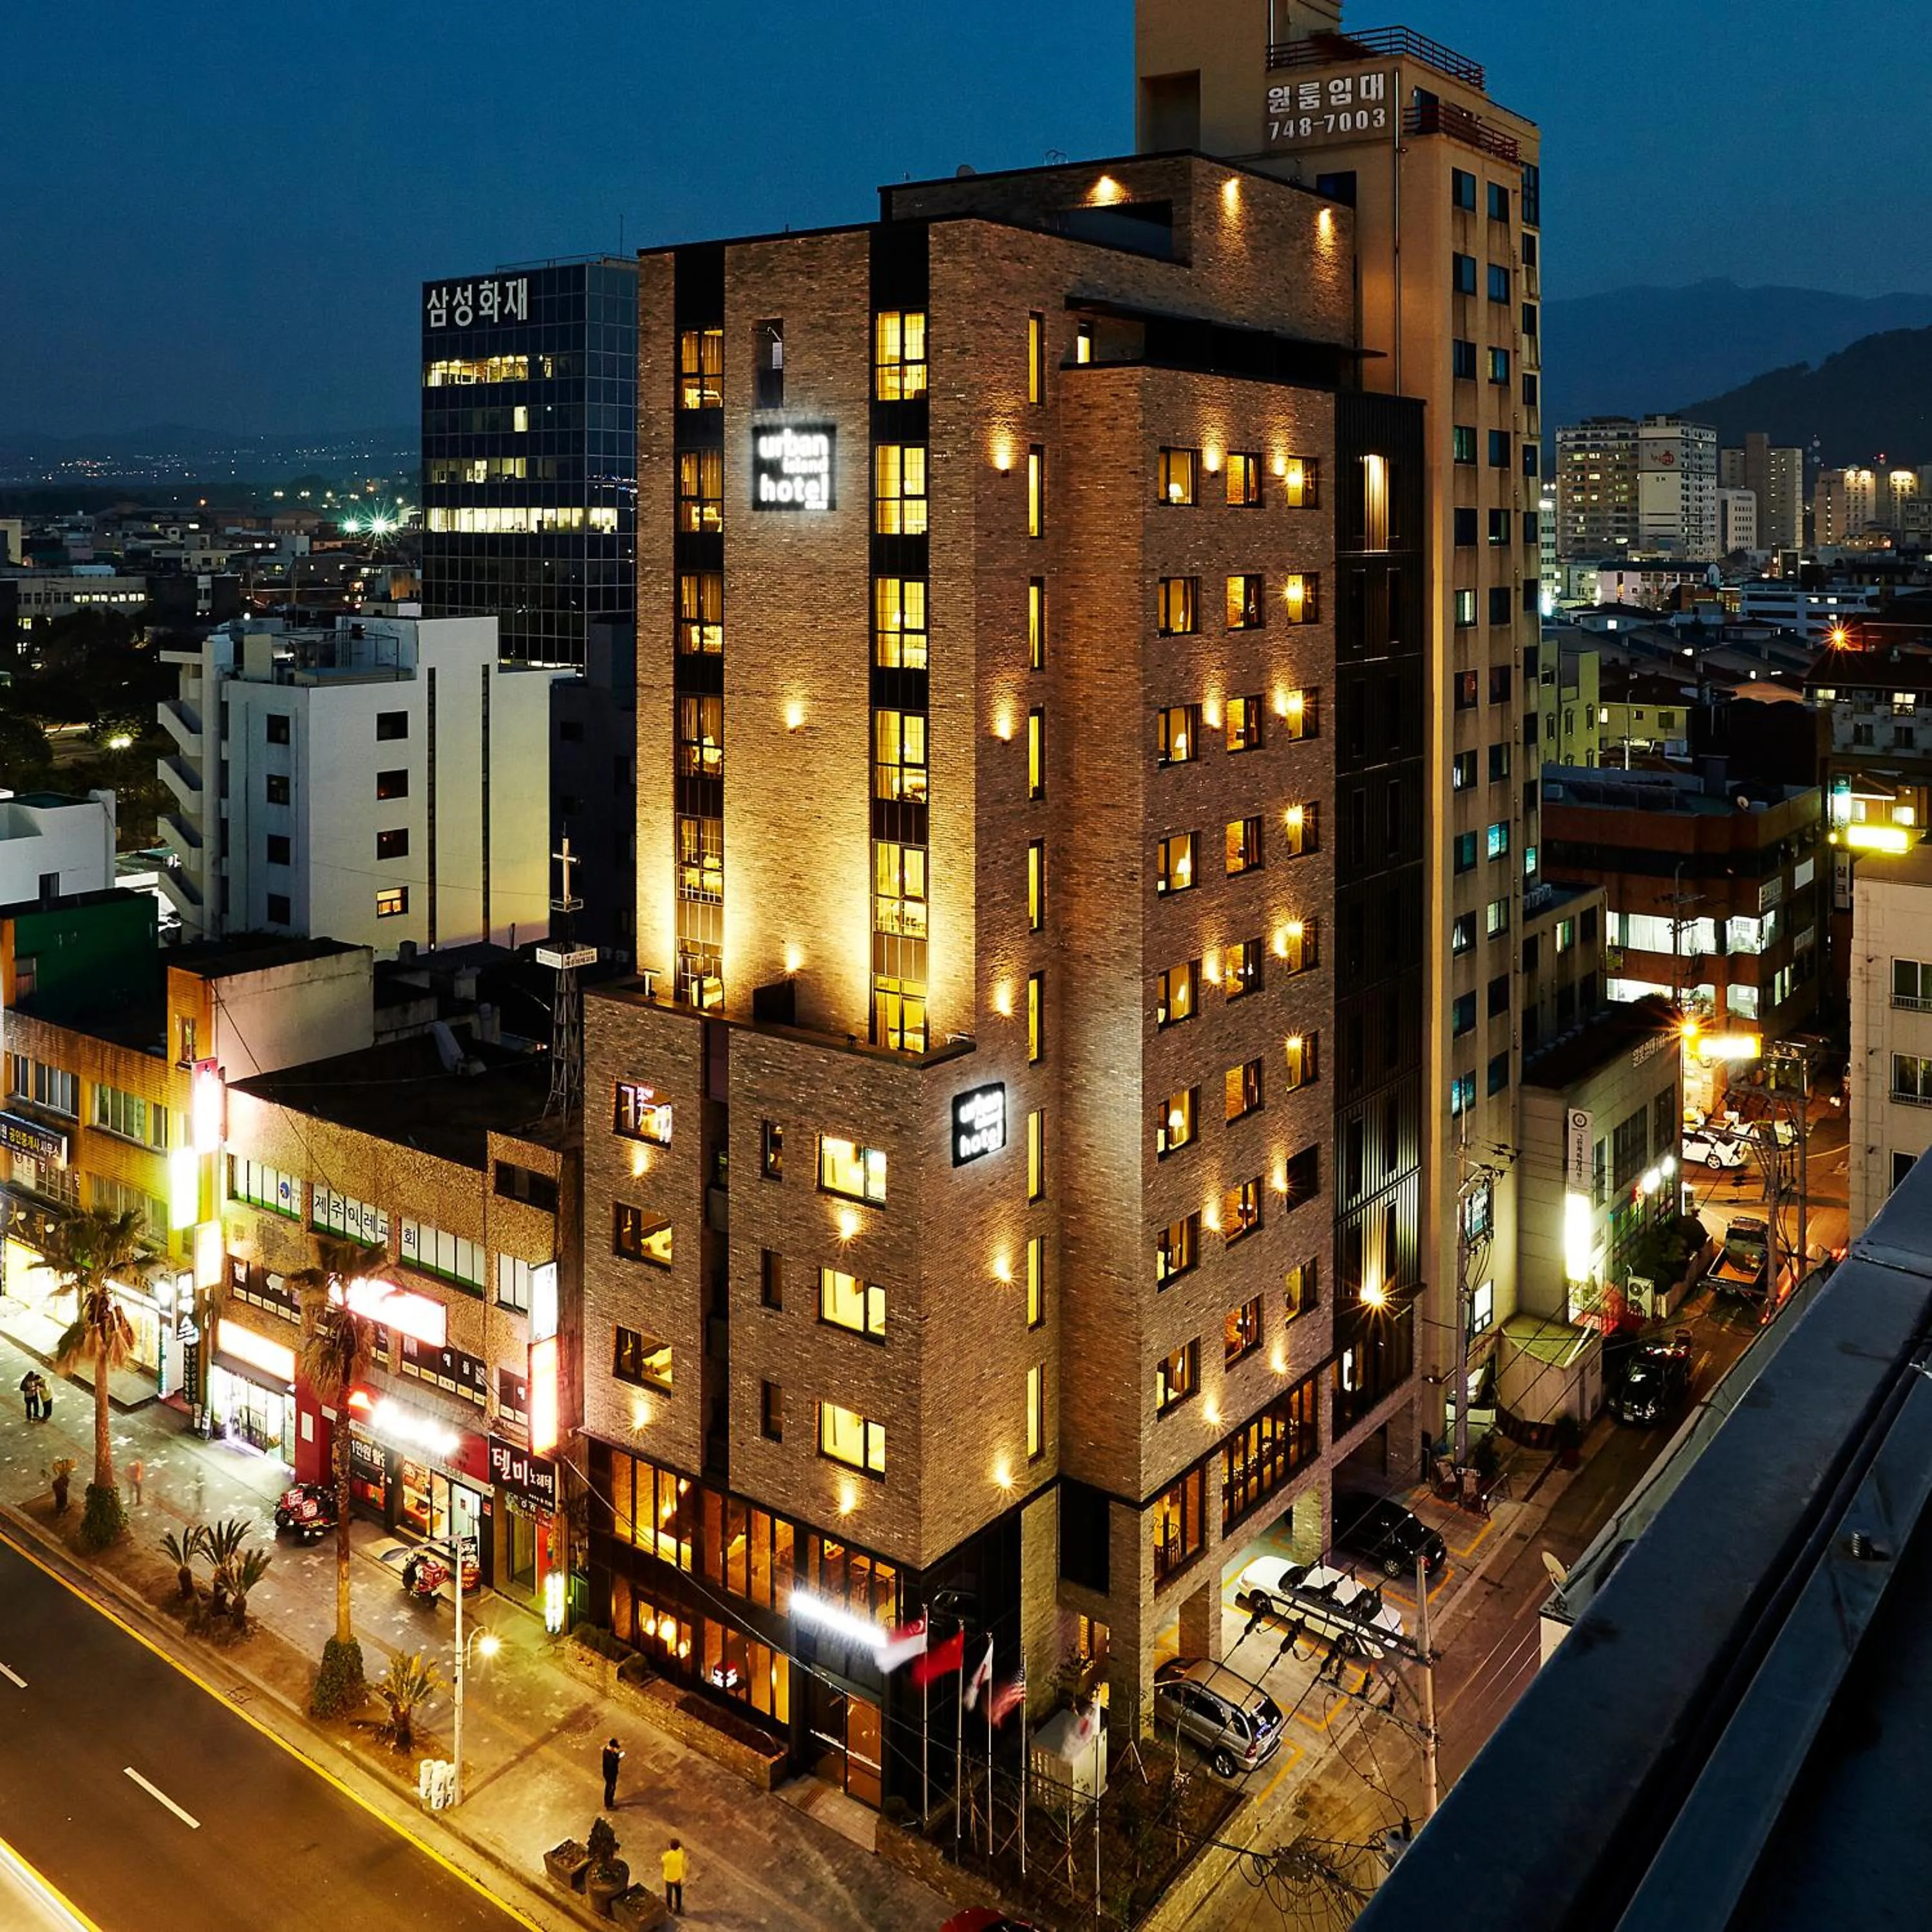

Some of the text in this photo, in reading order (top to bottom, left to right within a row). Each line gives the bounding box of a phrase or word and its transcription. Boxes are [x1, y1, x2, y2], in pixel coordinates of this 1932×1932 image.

[1268, 73, 1384, 114] 원룸임대
[1269, 108, 1385, 140] 748-7003
[427, 278, 527, 327] 삼성화재
[759, 428, 829, 458] urban
[760, 473, 829, 502] hotel
[491, 1448, 528, 1486] 텔미
